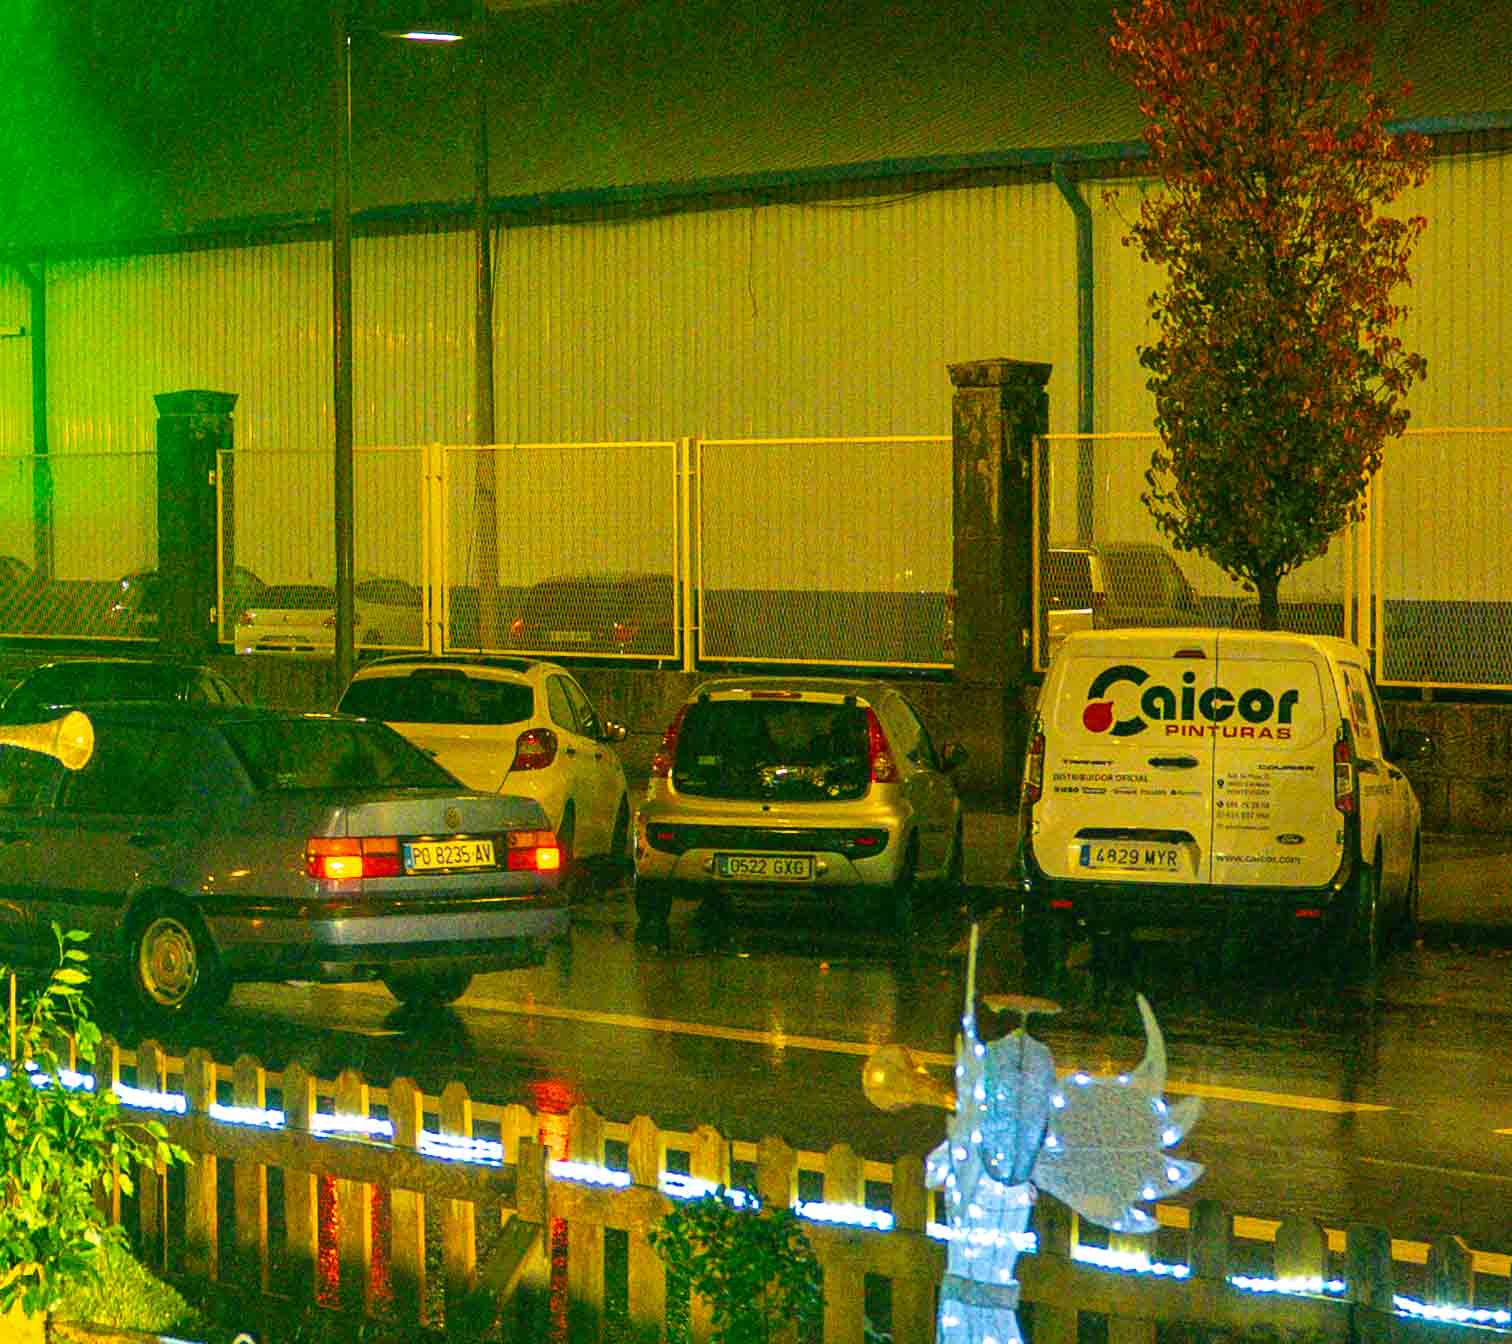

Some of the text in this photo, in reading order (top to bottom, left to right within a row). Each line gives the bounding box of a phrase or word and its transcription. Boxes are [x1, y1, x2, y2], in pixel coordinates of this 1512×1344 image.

[1083, 665, 1299, 737] Caicor
[1165, 725, 1292, 740] PINTURAS
[435, 845, 471, 865] 8235
[1095, 847, 1140, 865] 4829
[730, 858, 768, 874] 0522
